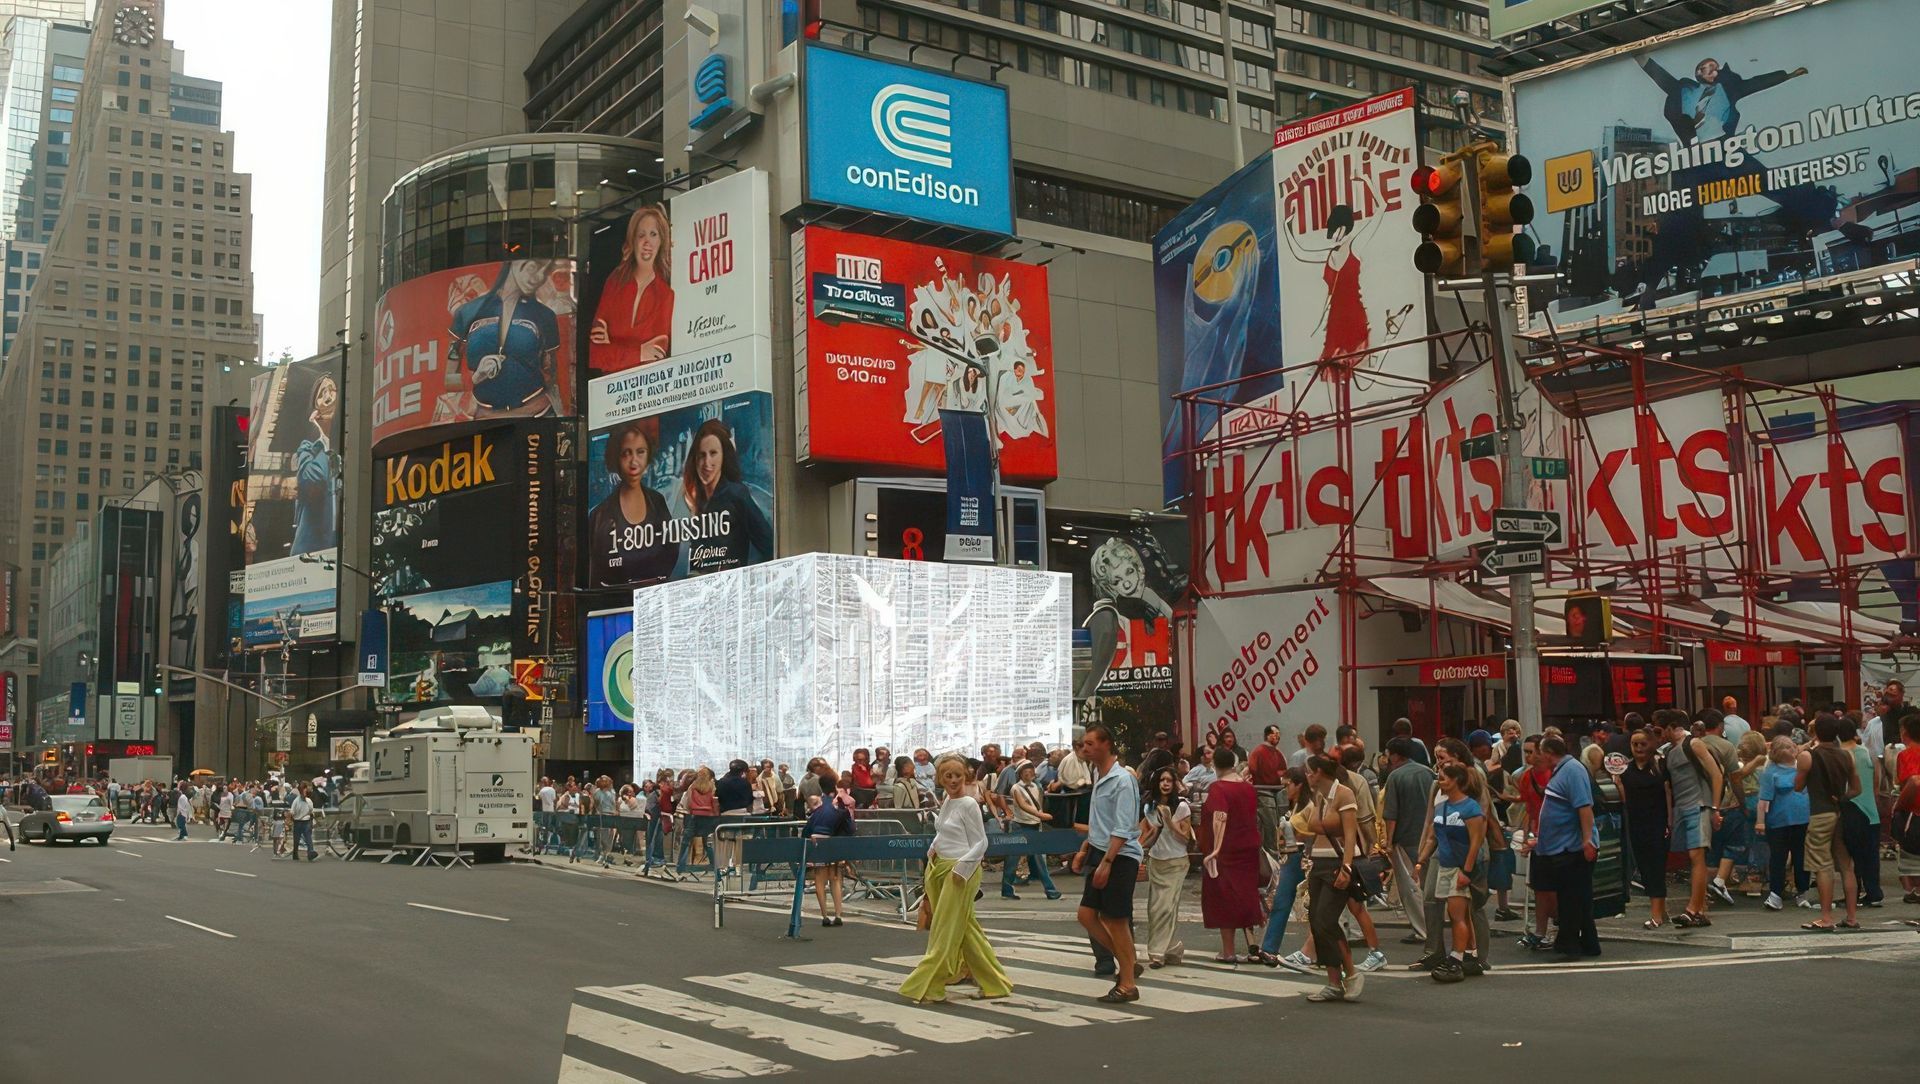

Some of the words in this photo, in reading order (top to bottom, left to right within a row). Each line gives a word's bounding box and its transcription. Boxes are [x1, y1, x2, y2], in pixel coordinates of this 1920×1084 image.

[1602, 120, 1804, 187] Washington
[847, 164, 980, 207] conEdison
[693, 212, 729, 248] WILD
[688, 240, 734, 285] CARD
[386, 434, 495, 506] Kodak
[1269, 648, 1319, 714] fund
